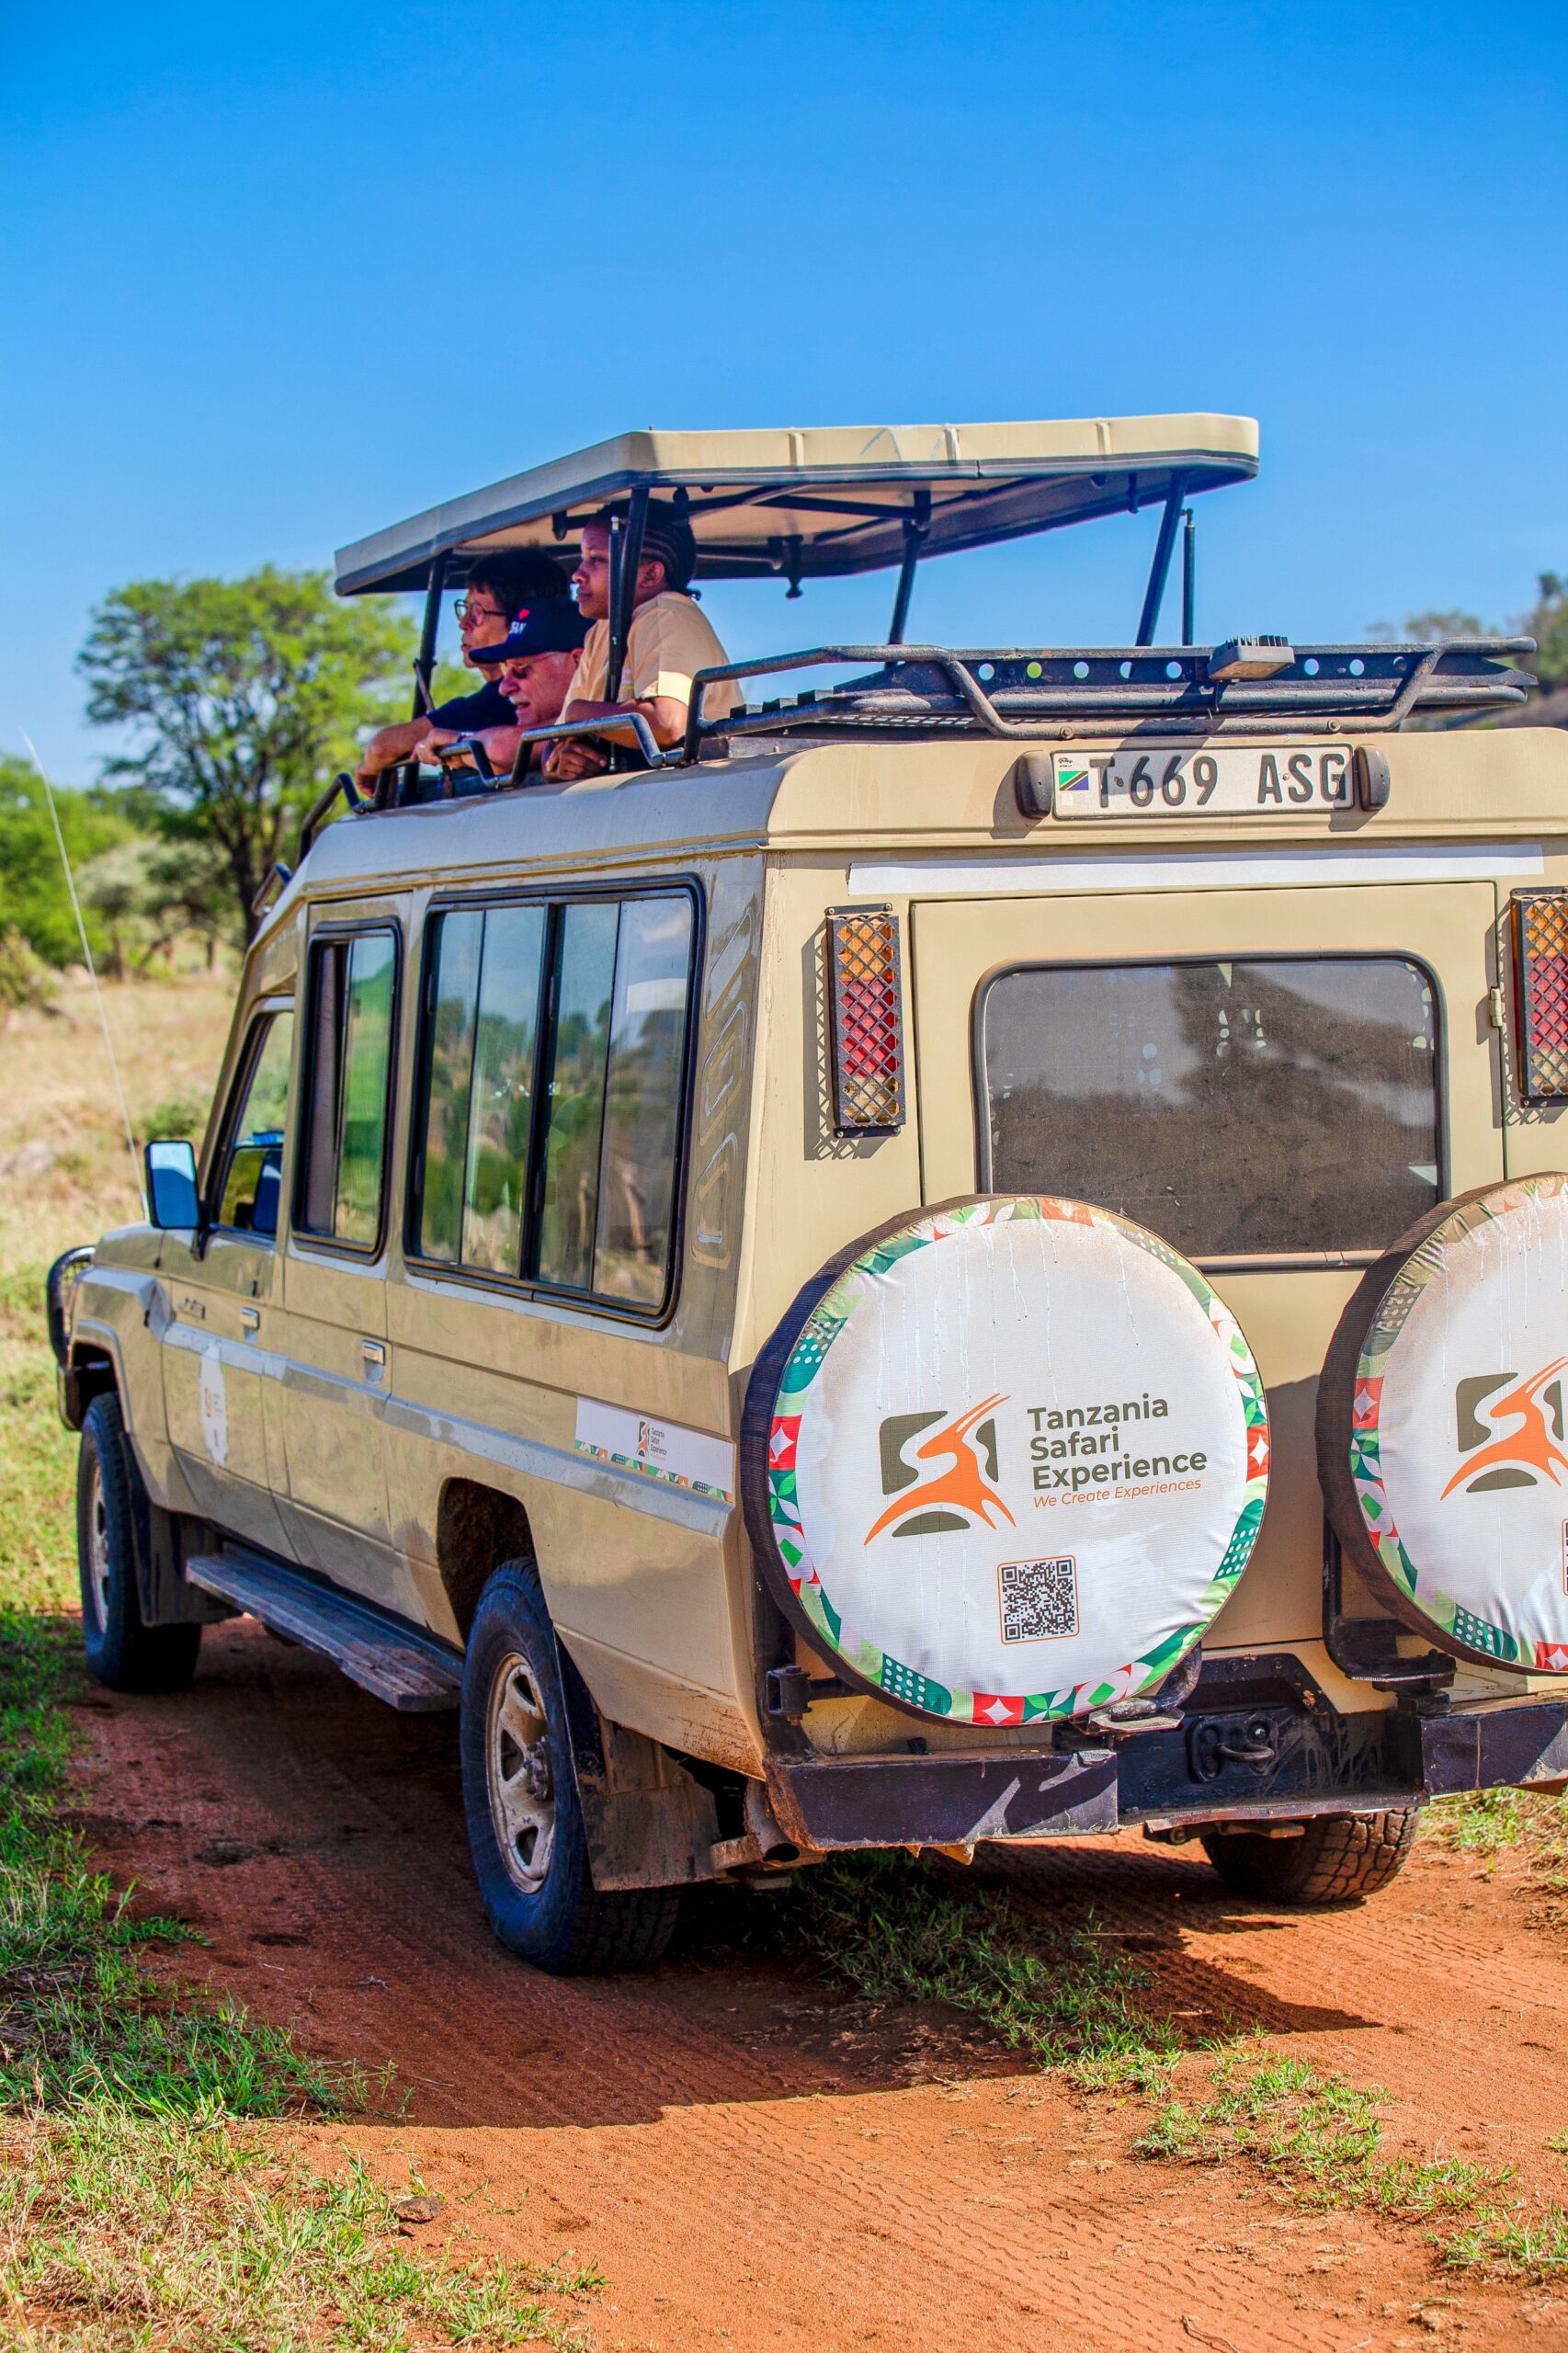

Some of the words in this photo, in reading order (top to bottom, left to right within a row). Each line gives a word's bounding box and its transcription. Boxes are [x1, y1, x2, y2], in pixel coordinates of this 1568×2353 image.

[1089, 758, 1115, 808] T
[1130, 754, 1218, 807] 669
[1257, 753, 1346, 803] ASG
[1027, 1392, 1168, 1431] Tanzania
[1030, 1426, 1119, 1461] Safari
[1032, 1452, 1208, 1492] Experience
[1034, 1493, 1057, 1508] We
[1062, 1488, 1110, 1505] Create
[1115, 1478, 1202, 1499] Experiences
